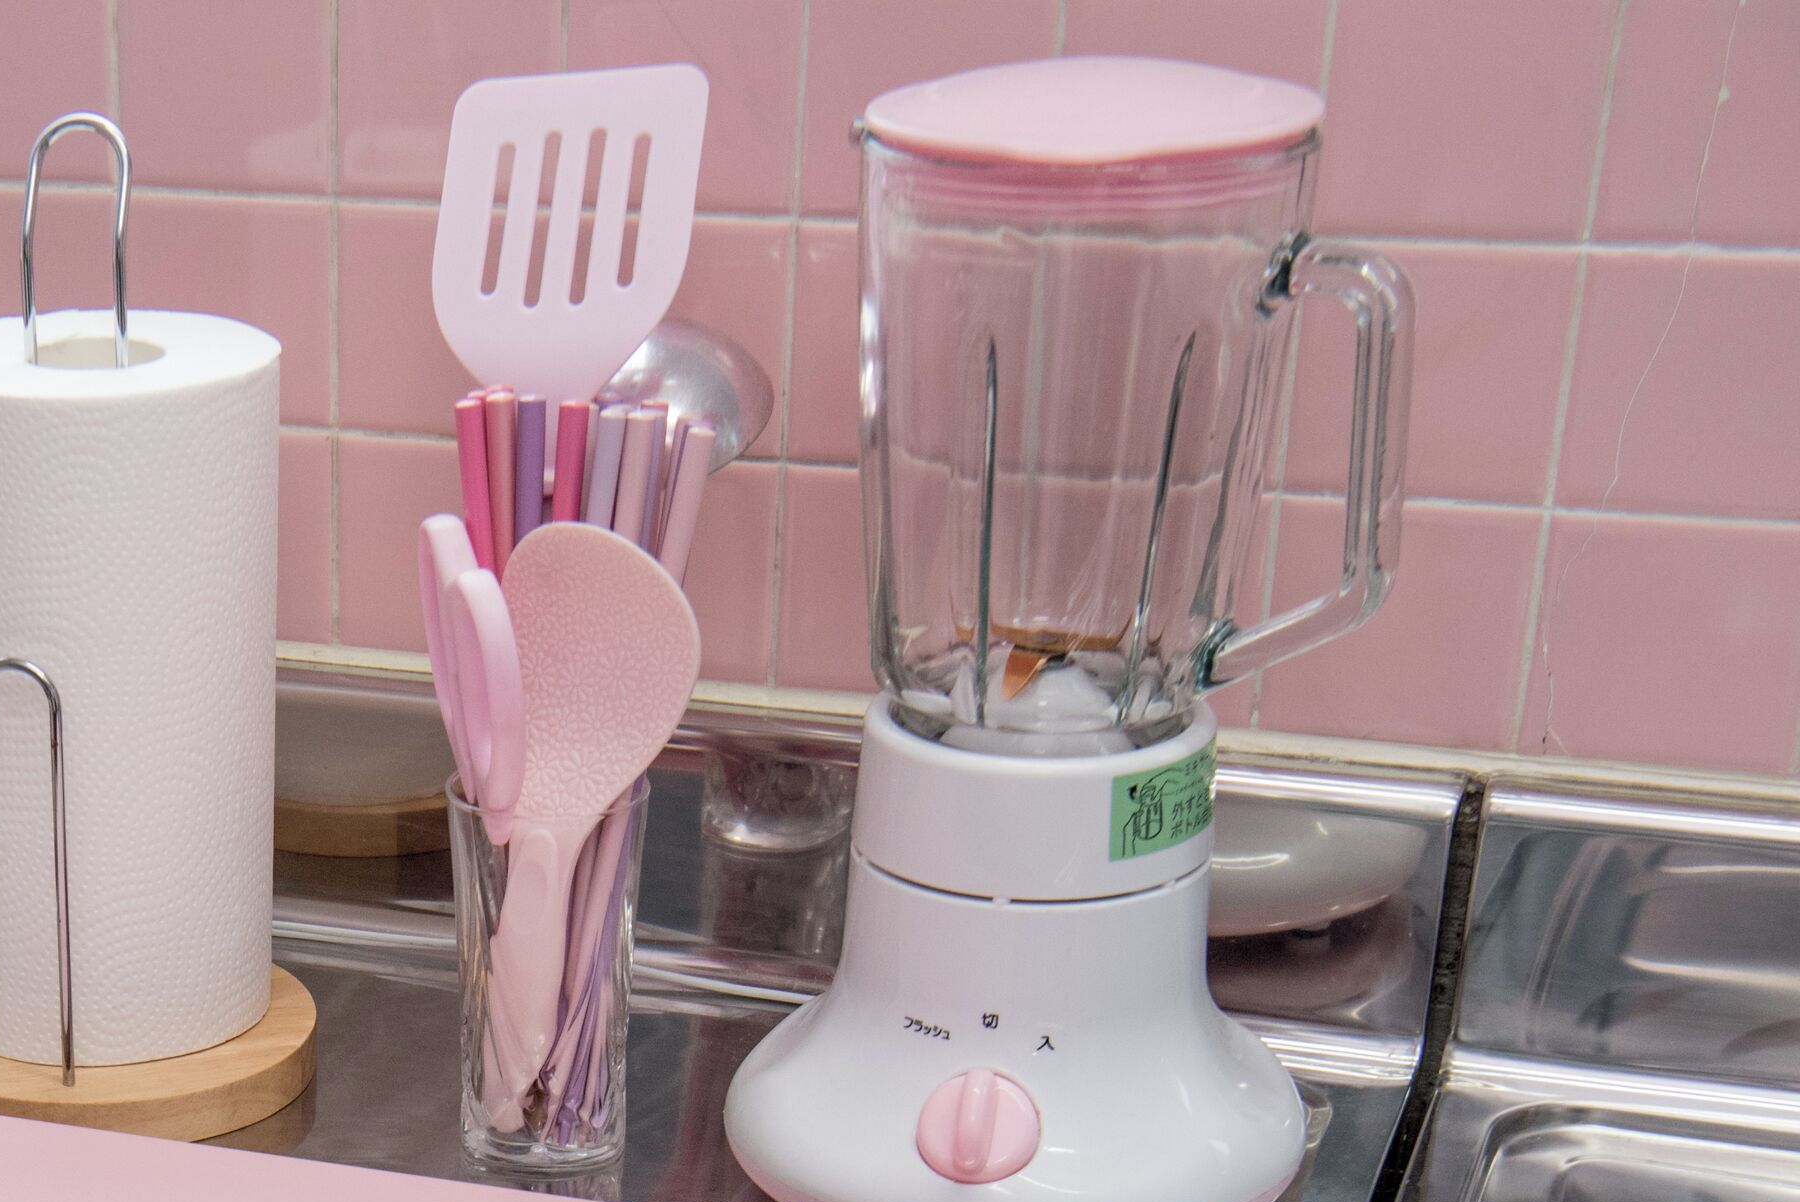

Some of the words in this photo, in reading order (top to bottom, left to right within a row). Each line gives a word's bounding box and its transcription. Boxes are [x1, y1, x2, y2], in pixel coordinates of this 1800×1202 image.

[903, 1015, 951, 1041] フラッシュ
[982, 1012, 999, 1029] 切
[1036, 1035, 1055, 1051] 入
